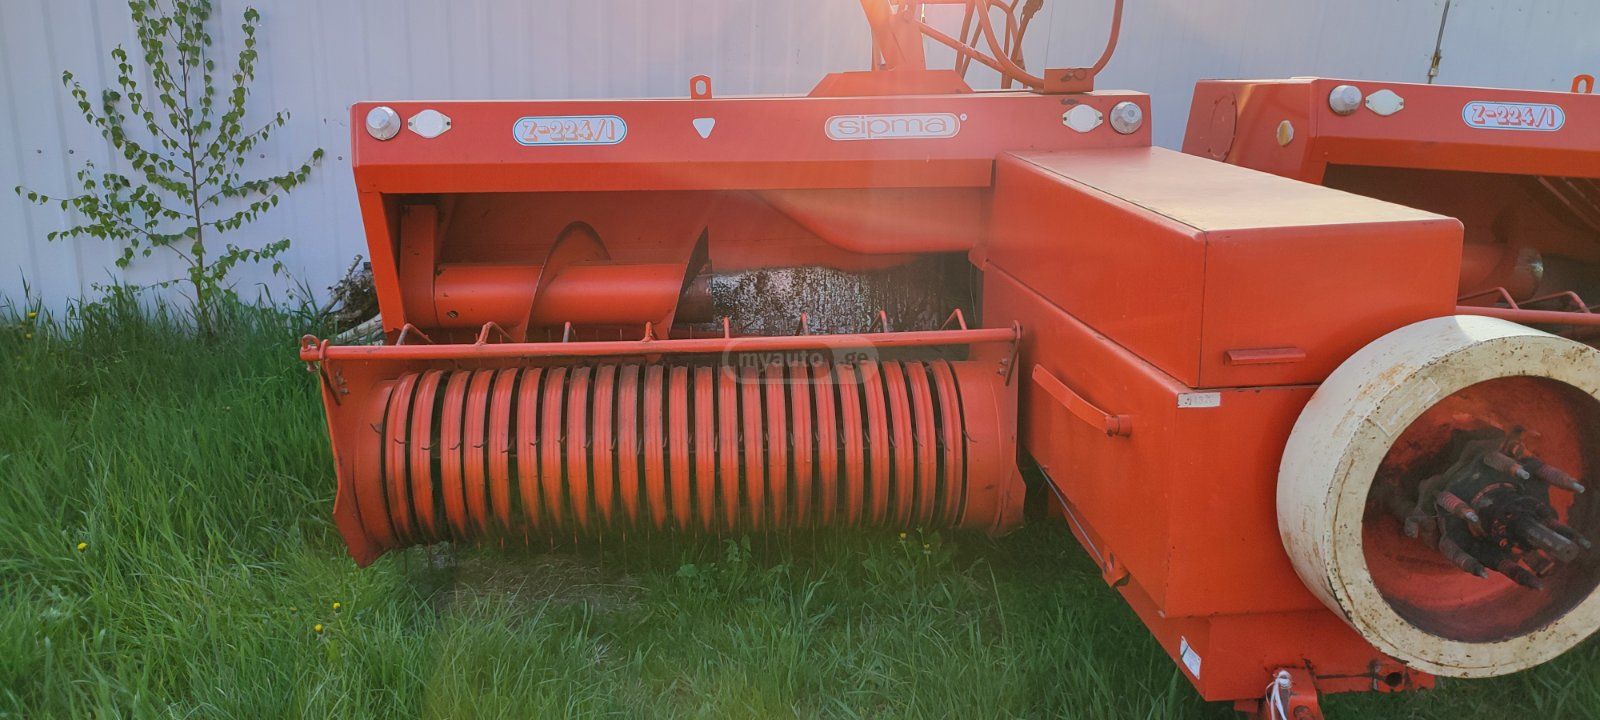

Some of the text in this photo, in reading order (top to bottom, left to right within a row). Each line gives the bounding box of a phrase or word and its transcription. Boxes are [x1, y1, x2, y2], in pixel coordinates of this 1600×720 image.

[837, 115, 947, 138] sipma
[1471, 105, 1555, 127] Z-224/1
[522, 119, 615, 142] Z-224/1
